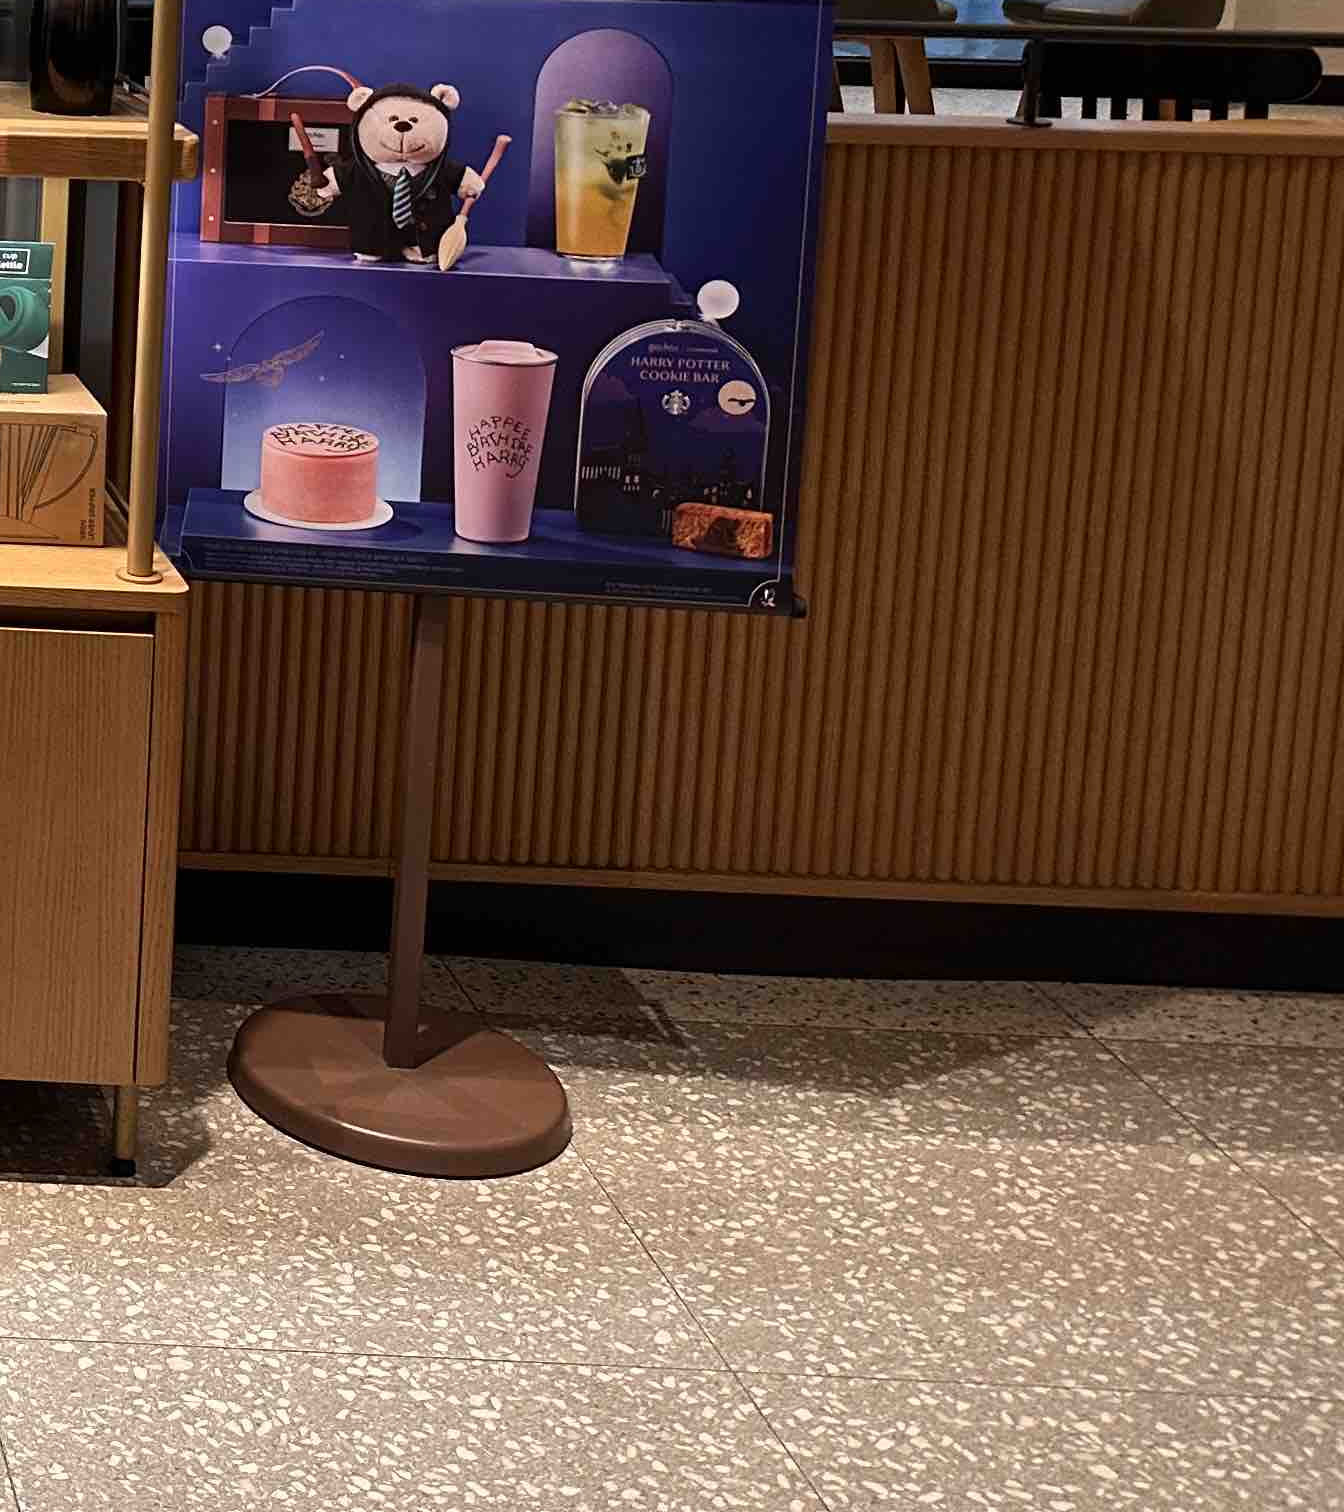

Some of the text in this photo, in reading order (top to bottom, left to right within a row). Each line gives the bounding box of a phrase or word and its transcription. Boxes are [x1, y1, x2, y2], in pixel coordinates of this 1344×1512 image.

[2, 252, 18, 262] cup
[630, 355, 731, 371] HARRY POTTER
[639, 369, 721, 384] COOKIE BAR
